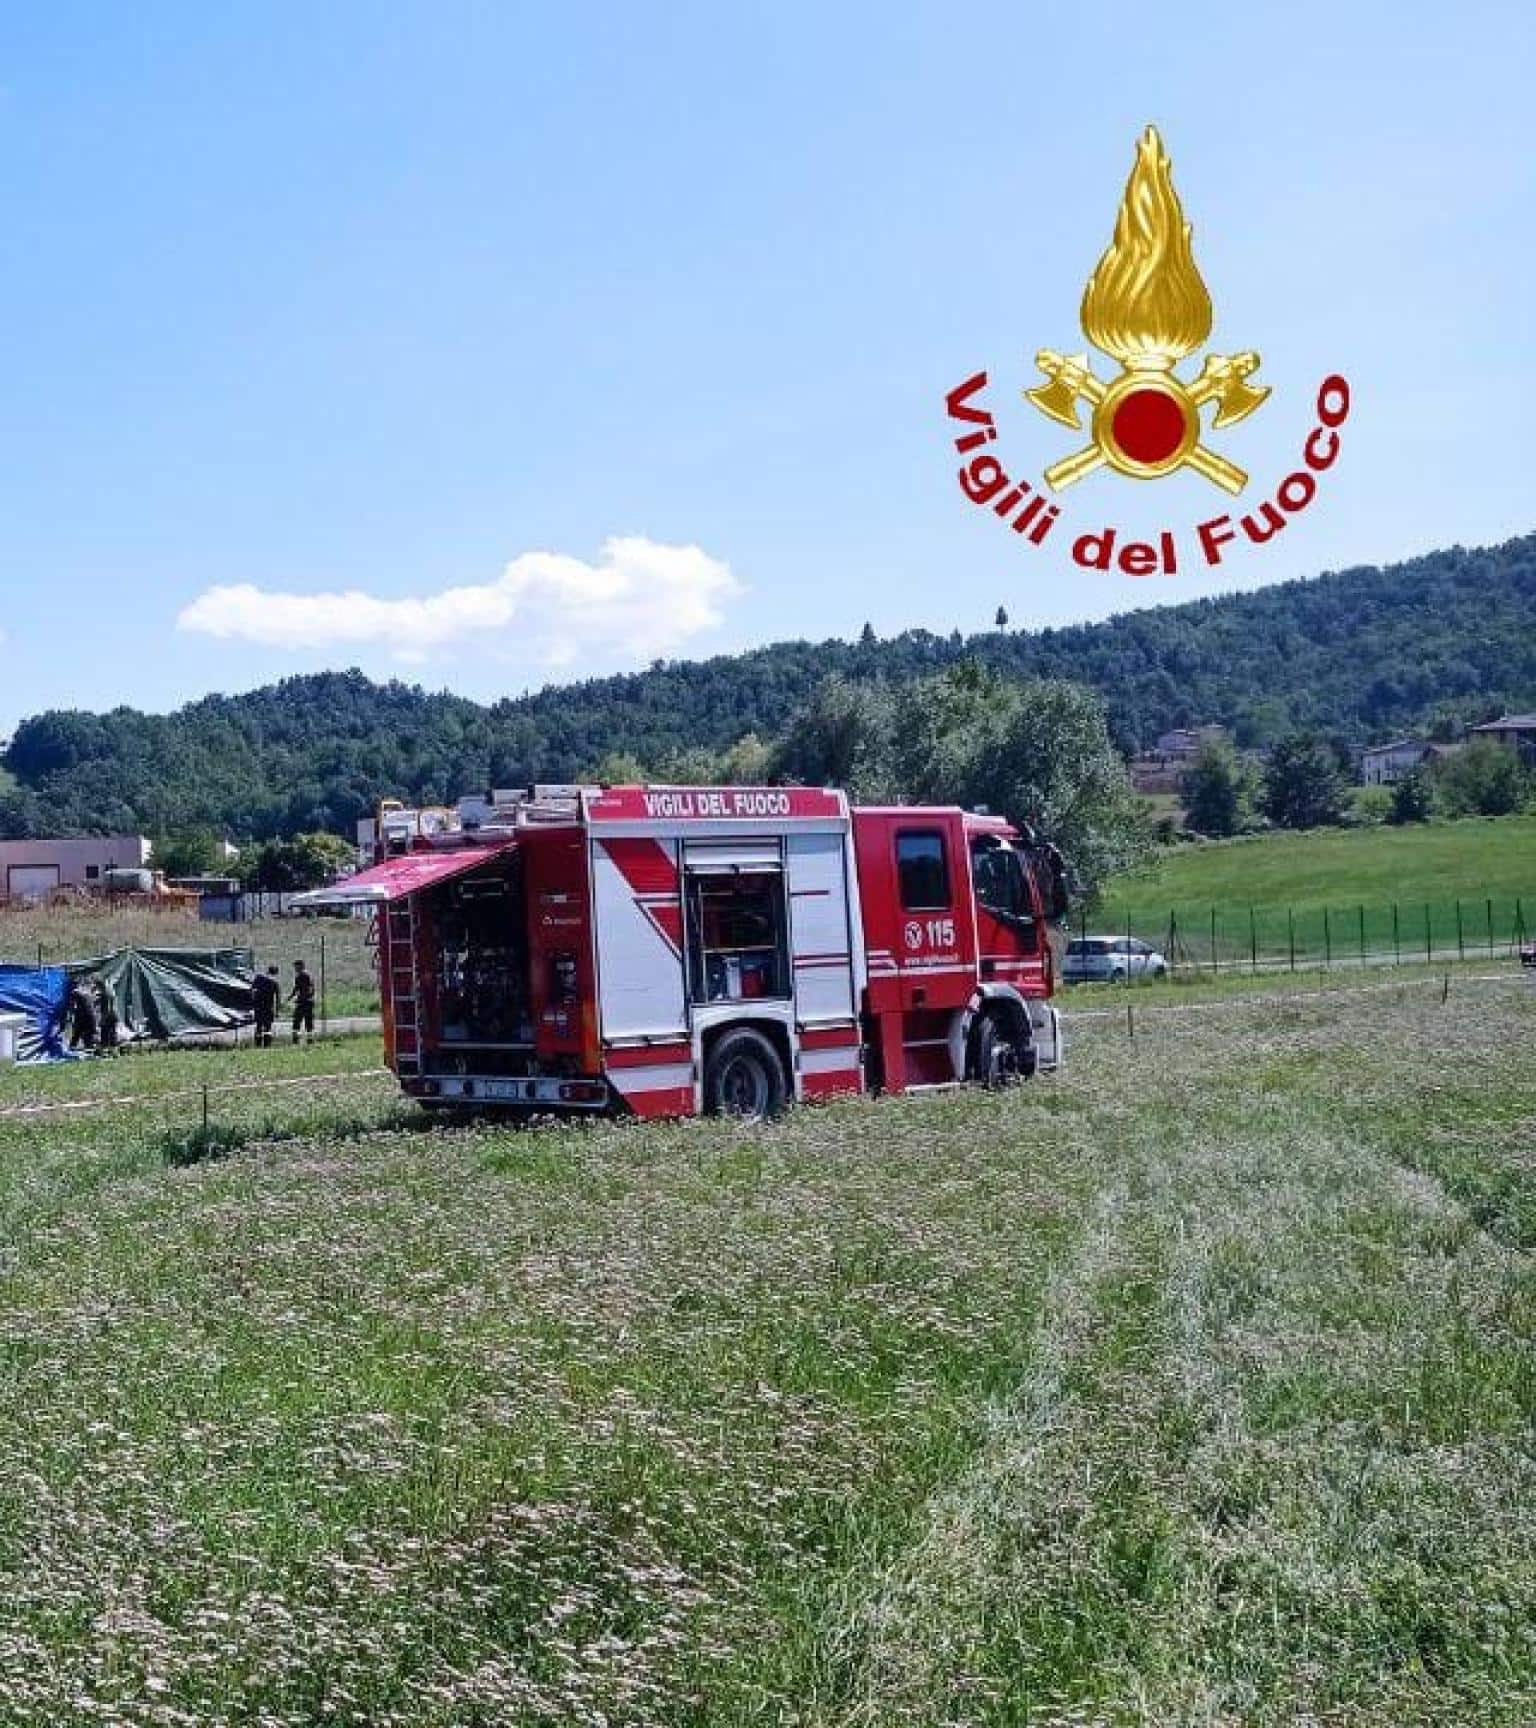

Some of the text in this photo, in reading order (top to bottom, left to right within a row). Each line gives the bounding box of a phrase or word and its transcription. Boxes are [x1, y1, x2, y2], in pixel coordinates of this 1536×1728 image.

[643, 793, 791, 817] VIGILI DEL FUOCO
[926, 919, 956, 948] 115
